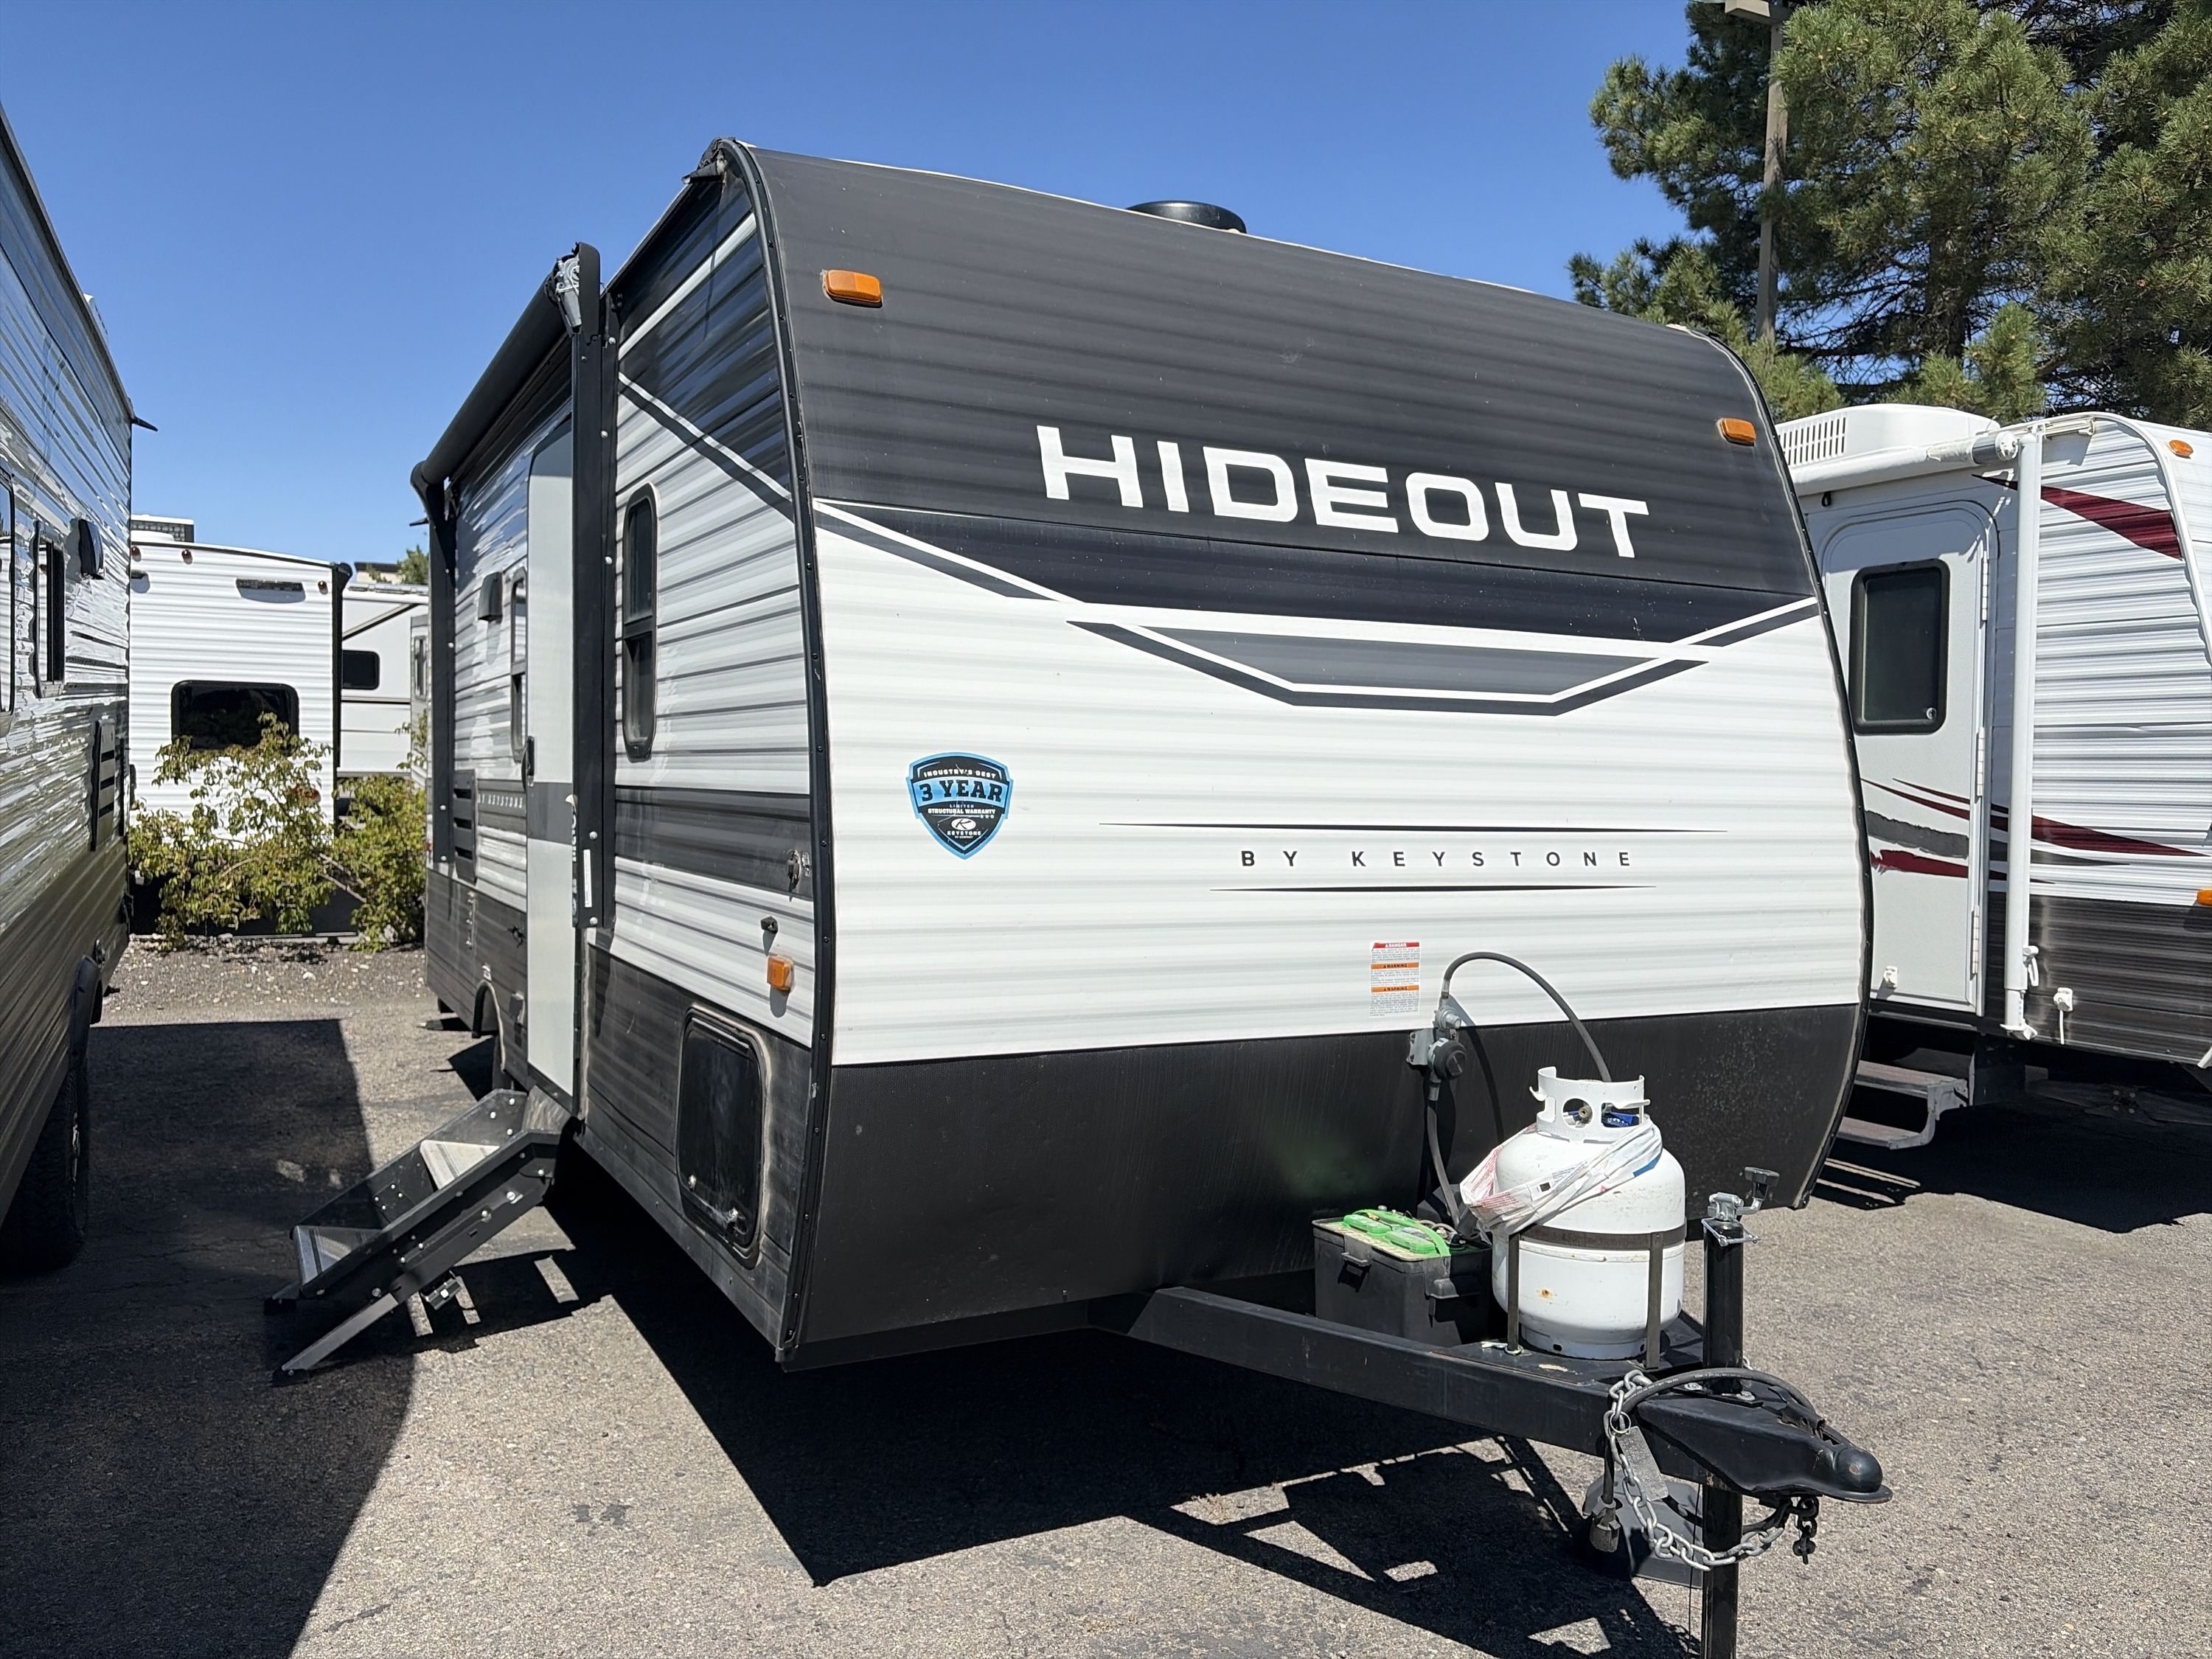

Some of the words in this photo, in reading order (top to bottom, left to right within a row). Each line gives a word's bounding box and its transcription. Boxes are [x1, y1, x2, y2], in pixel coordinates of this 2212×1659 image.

[1036, 425, 1649, 558] HIDEOUT
[923, 768, 973, 778] INDUSTRY'S
[975, 770, 996, 779] BEST
[919, 783, 933, 802] 3
[939, 779, 1003, 802] YEAR
[1241, 850, 1298, 867] BY
[1351, 850, 1630, 867] KEYSTONE
